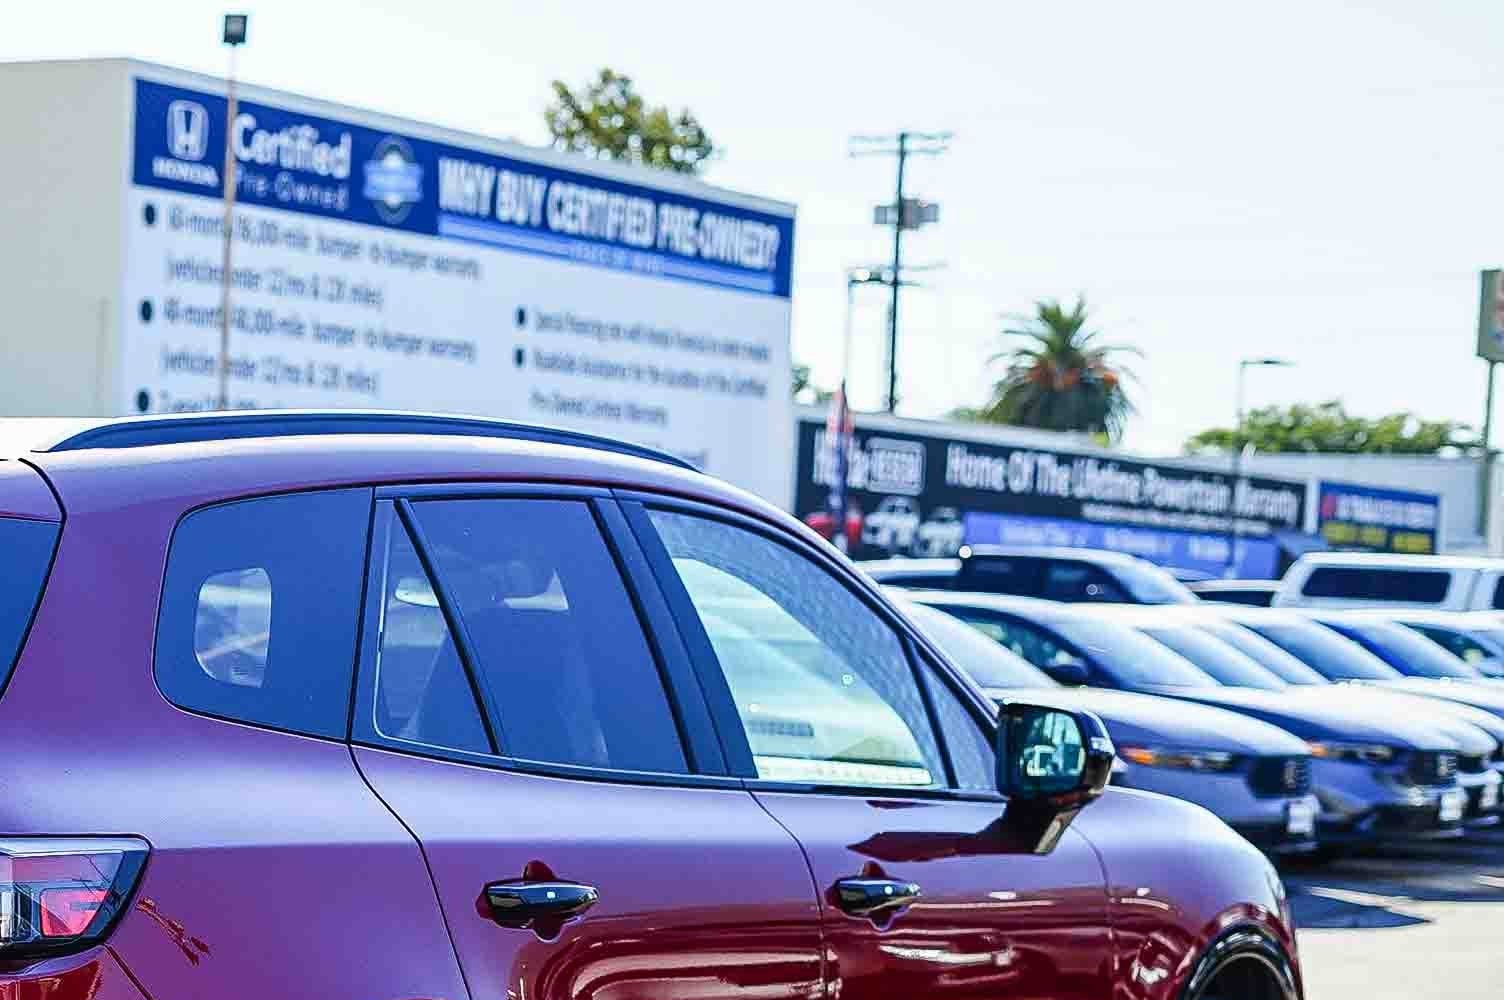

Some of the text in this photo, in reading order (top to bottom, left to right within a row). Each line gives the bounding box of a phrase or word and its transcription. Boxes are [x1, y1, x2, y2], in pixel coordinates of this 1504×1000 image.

[234, 113, 353, 180] Certified
[439, 157, 494, 218] WHY
[496, 170, 546, 227] BUY
[547, 180, 656, 248] CERTIFIED
[946, 441, 1006, 492] Home
[1008, 451, 1037, 494] Of
[1037, 453, 1071, 498] The
